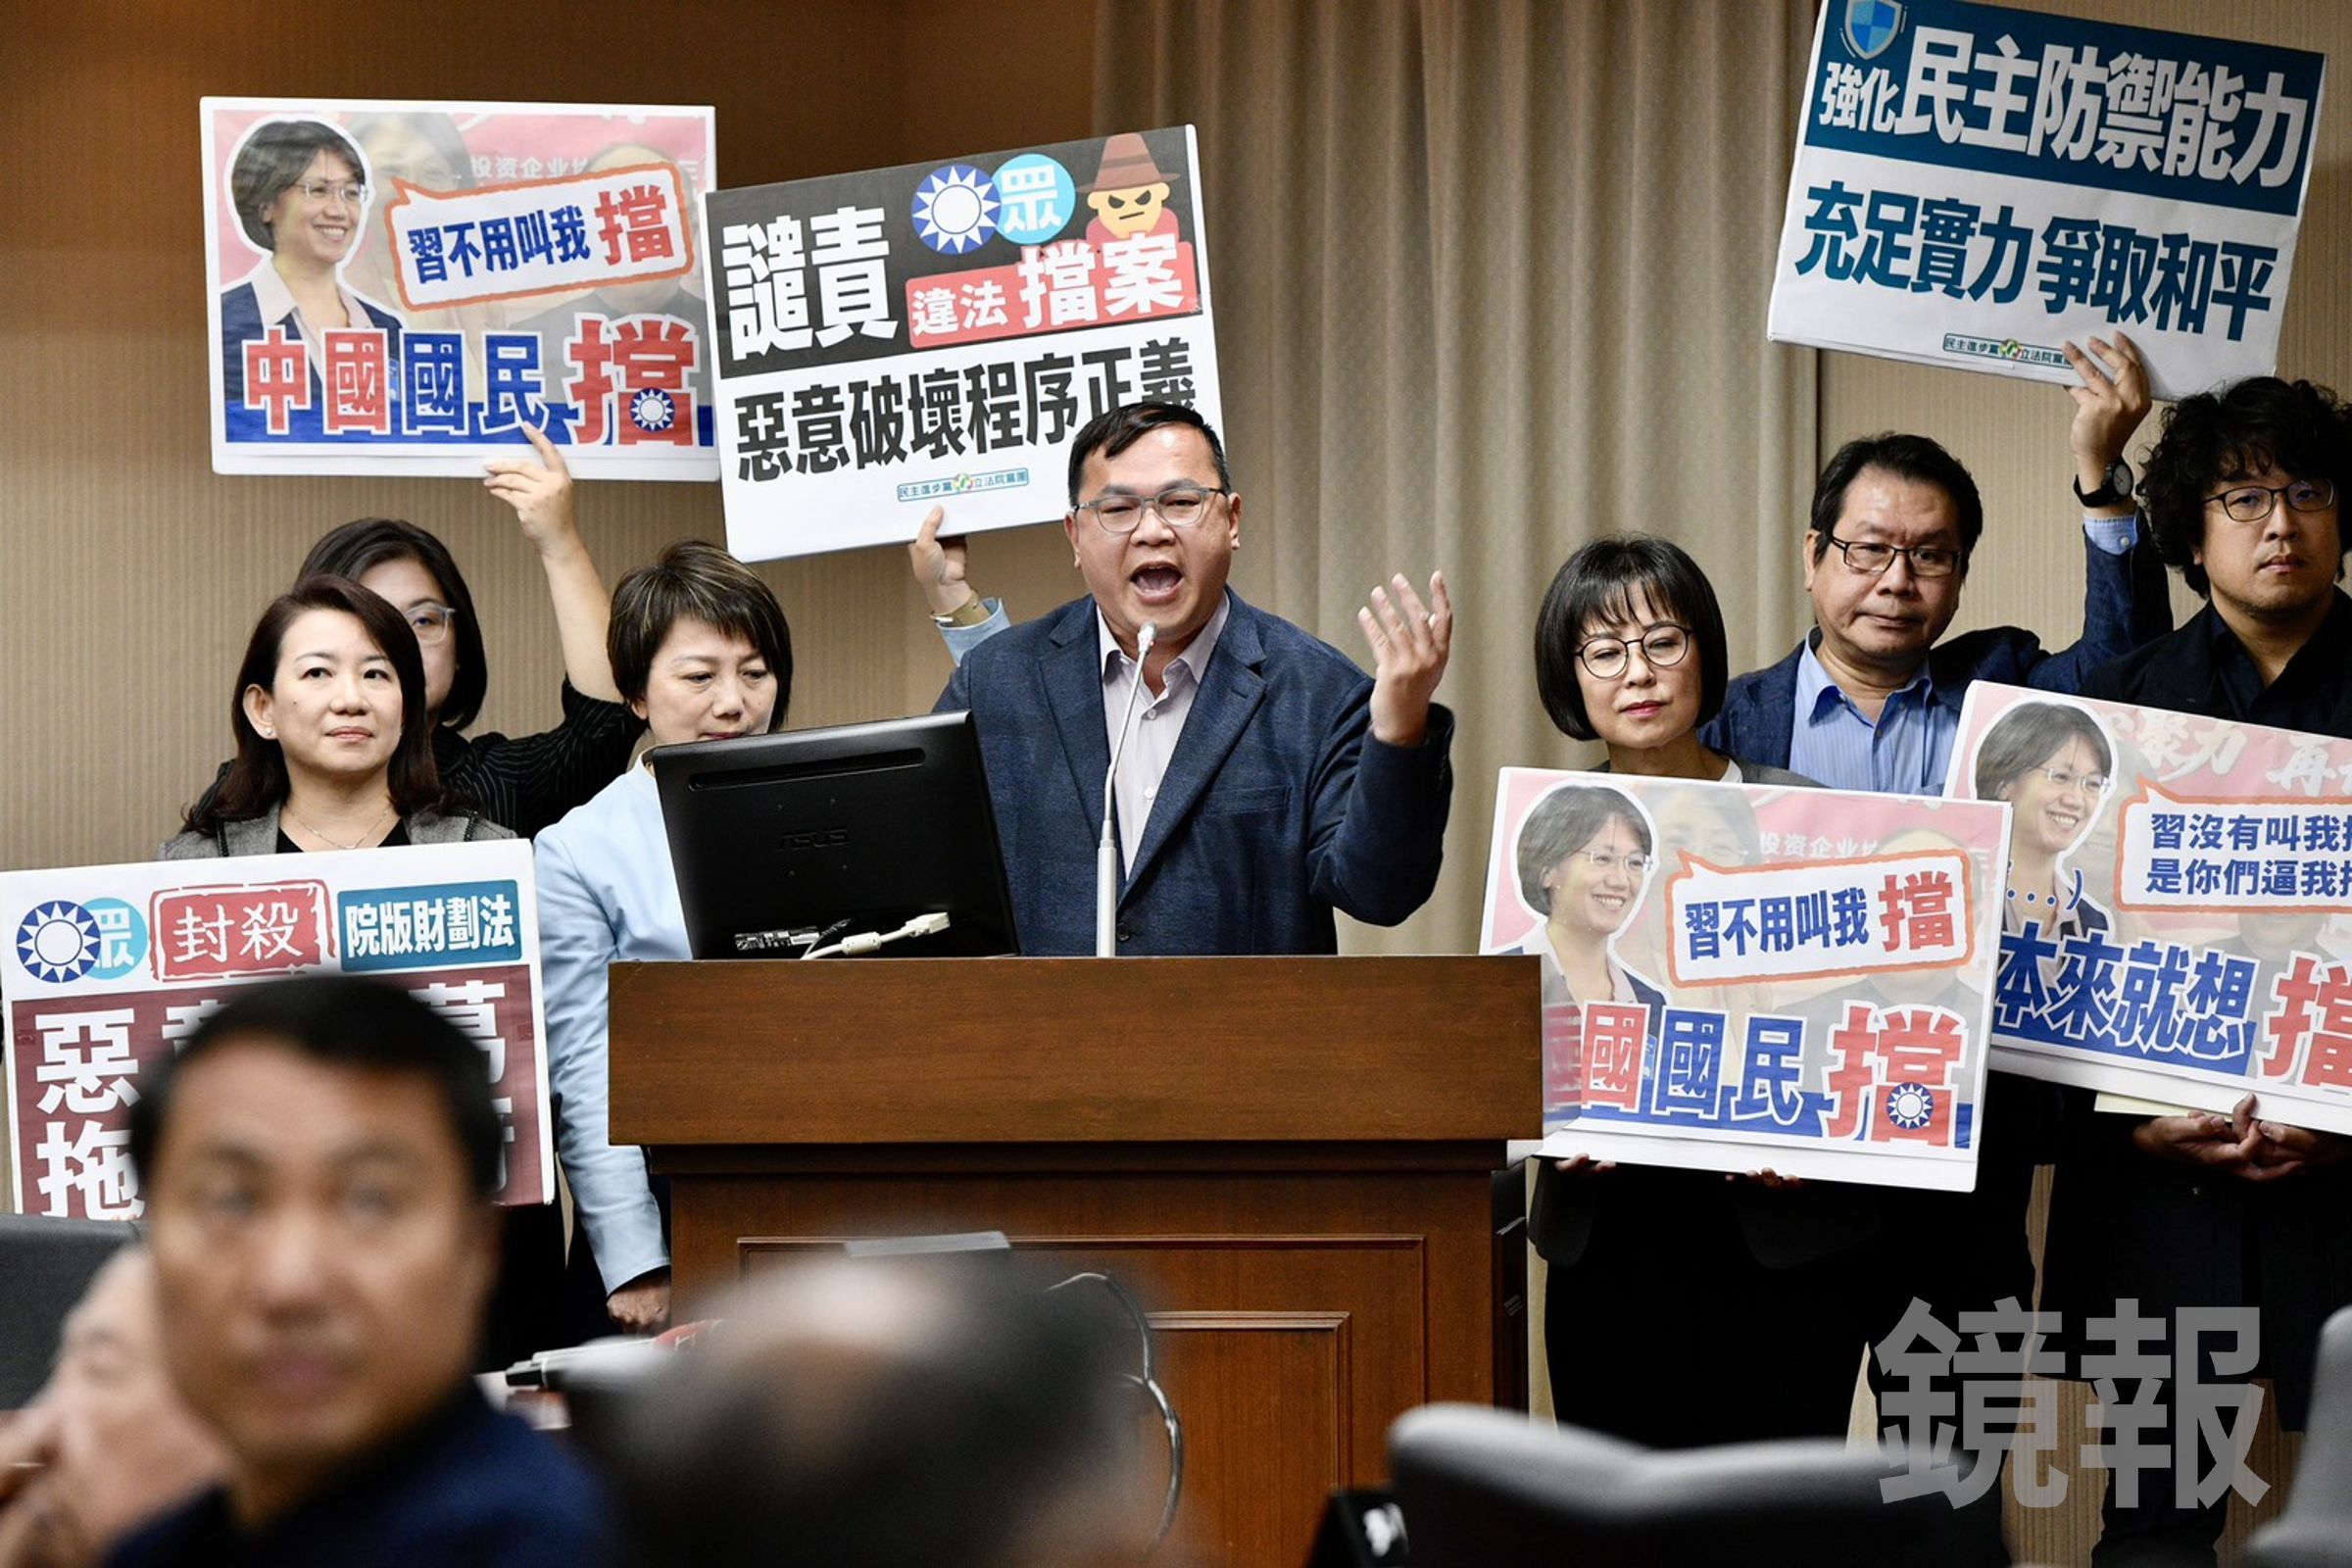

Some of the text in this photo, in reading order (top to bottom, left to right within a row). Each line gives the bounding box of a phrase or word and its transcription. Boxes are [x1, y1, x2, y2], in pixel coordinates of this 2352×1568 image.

[1819, 25, 2308, 188] 強化民主防禦能力
[407, 184, 675, 284] 習不用叫我擋
[1001, 165, 1061, 232] 眾
[722, 207, 899, 361] 譴責
[911, 232, 1184, 337] 違法擋案
[1795, 180, 2278, 342] 充足實力 爭取和平
[245, 319, 696, 448] 中國國民擋
[734, 337, 1196, 482] 惡意破壞程序正義
[776, 827, 849, 852] ASUS
[172, 901, 304, 963] 封殺
[346, 894, 516, 958] 院版財劃法
[1685, 870, 1954, 960] 習不用叫我擋
